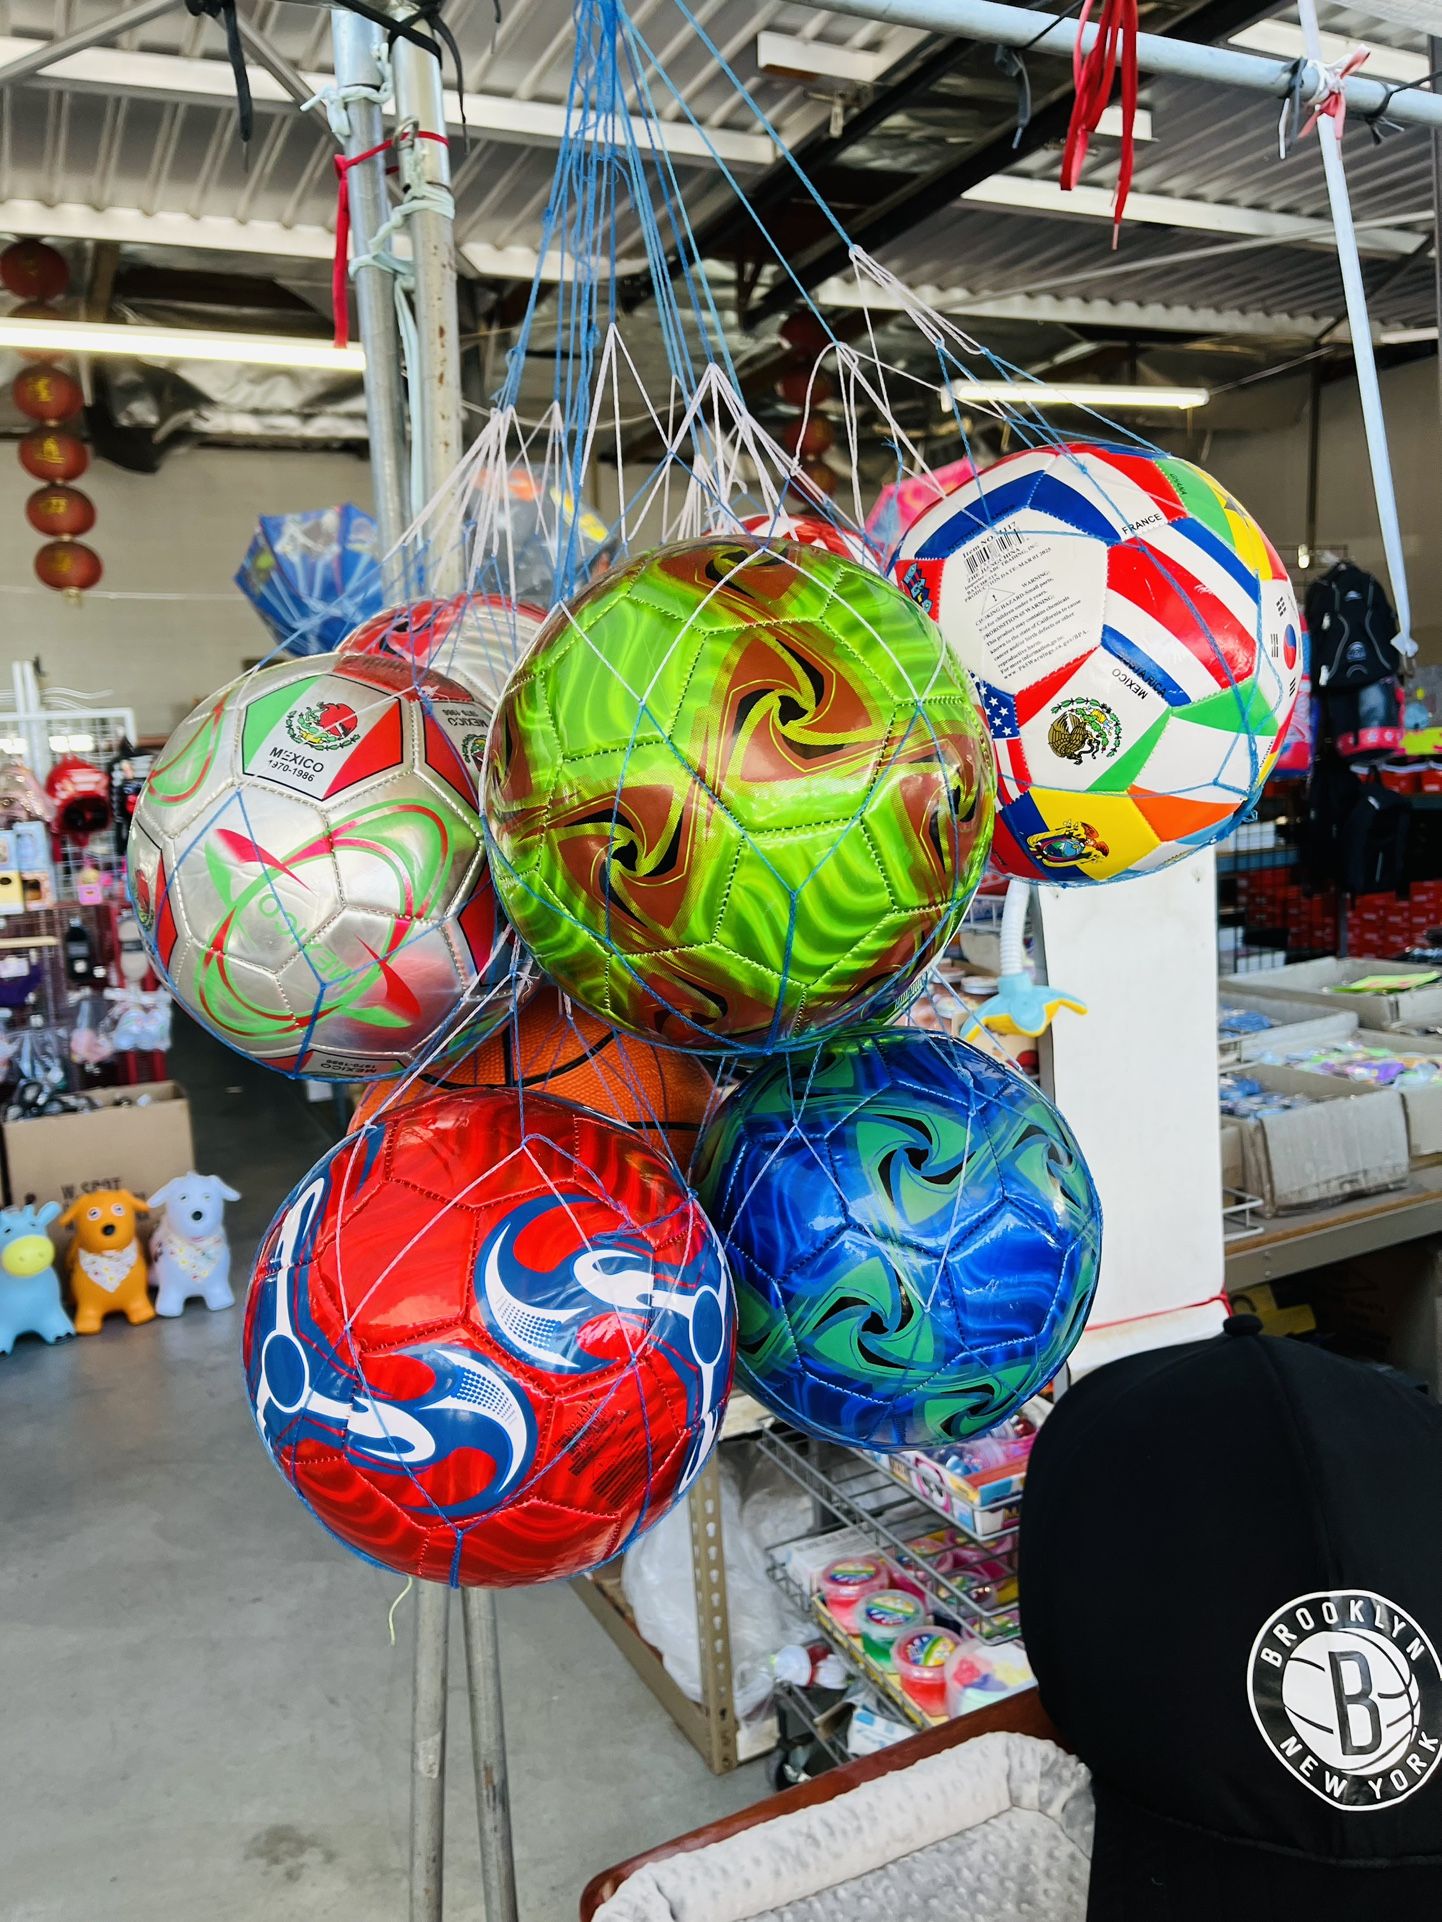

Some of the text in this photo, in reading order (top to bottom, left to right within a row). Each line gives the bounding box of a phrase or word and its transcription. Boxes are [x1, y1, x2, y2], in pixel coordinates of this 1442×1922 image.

[1121, 513, 1162, 535] FRANCE
[963, 546, 980, 558] Item
[965, 578, 1000, 602] PRODUCION
[1019, 558, 1032, 567] MAR
[995, 609, 1014, 622] children
[1015, 601, 1028, 610] under
[997, 628, 1015, 641] product
[1046, 597, 1069, 611] chemicals
[990, 643, 1006, 654] known
[1020, 628, 1030, 636] state
[1037, 611, 1061, 625] California
[1068, 600, 1081, 609] cause
[994, 650, 1009, 661] cancer
[1025, 633, 1038, 641] birth
[1038, 624, 1055, 634] defects
[1062, 612, 1074, 621] other
[998, 649, 1027, 668] reproductive
[1010, 660, 1021, 668] more
[1112, 668, 1149, 700] MEXICO
[269, 746, 324, 773] MEXICO
[269, 759, 315, 782] 1970-1986
[320, 1063, 377, 1073] MEXICO
[1260, 1600, 1425, 1668] BROOKLYN
[1328, 1651, 1383, 1755] B
[1279, 1731, 1439, 1800] NEW YORK
